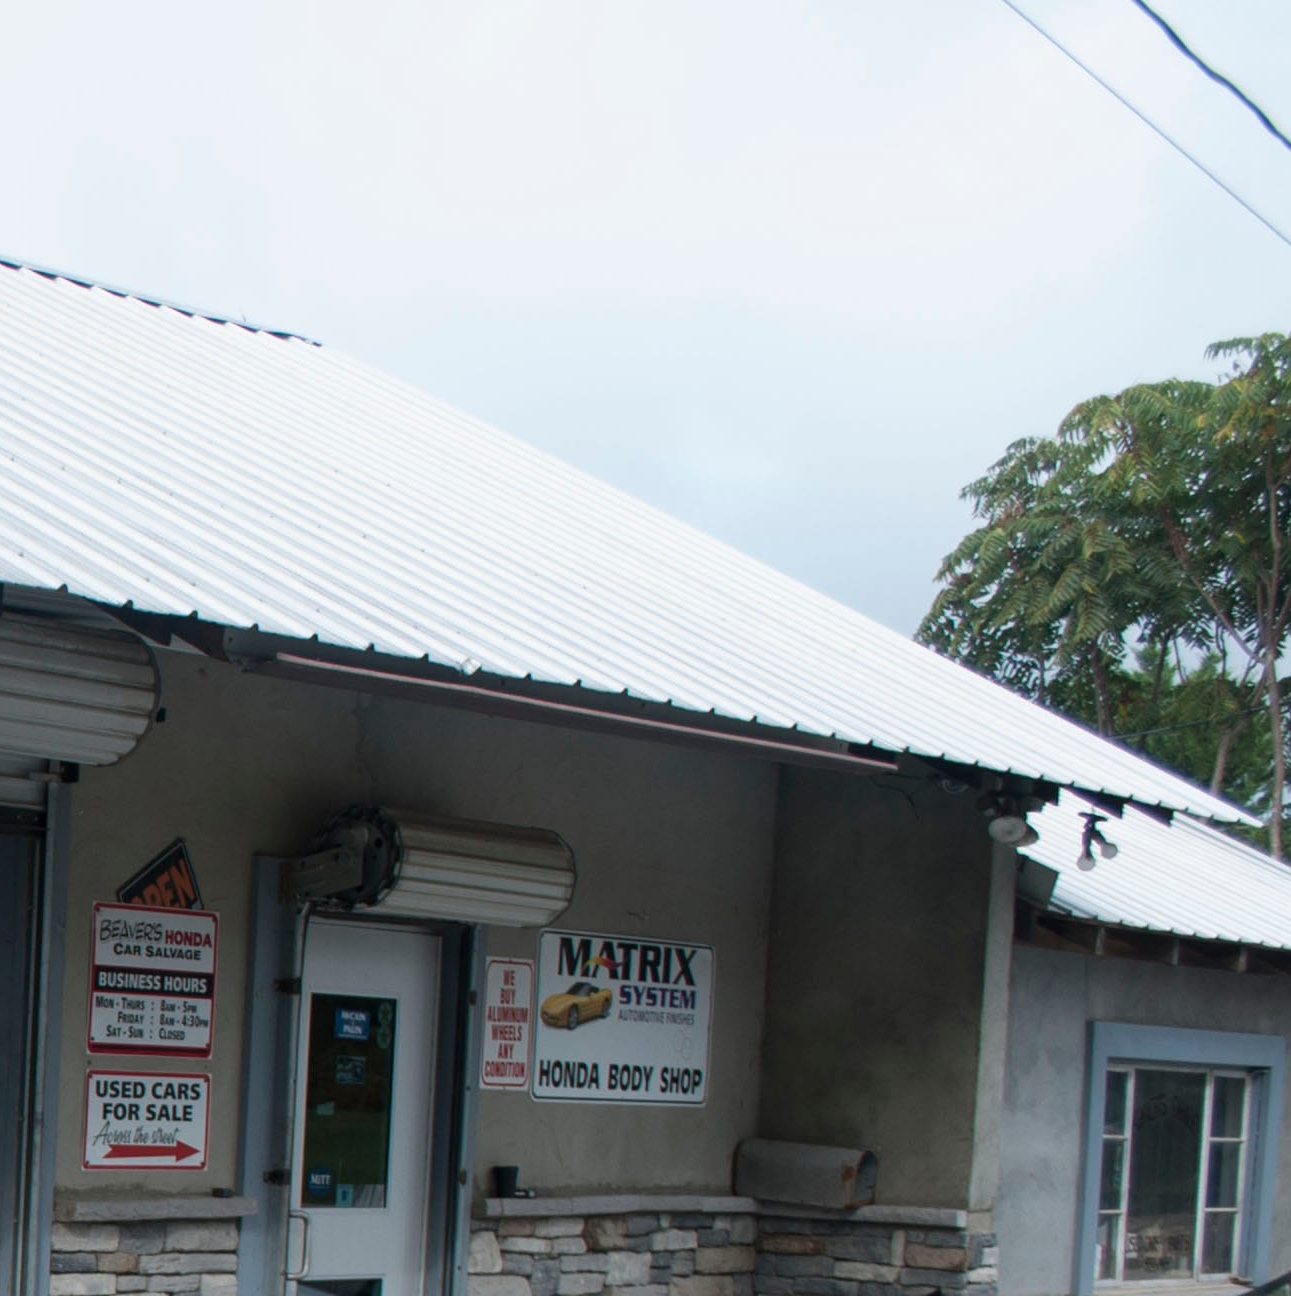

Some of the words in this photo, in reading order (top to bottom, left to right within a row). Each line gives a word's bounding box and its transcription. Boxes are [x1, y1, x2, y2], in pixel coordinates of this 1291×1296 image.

[100, 918, 163, 942] BEAVER'S
[165, 930, 212, 948] HONDA
[113, 943, 141, 956] CAR
[145, 945, 201, 961] SALVAGE
[557, 936, 698, 987] MATRIX
[98, 971, 161, 990] BUSINESS
[163, 975, 207, 993] HOURS
[503, 970, 516, 987] WE
[500, 988, 517, 1005] BUY
[619, 984, 697, 1010] SYSTEM
[487, 1006, 528, 1022] ALUMINUM
[618, 1010, 665, 1025] AUTOMOTIVE
[665, 1012, 695, 1025] FINISHES
[491, 1024, 523, 1041] WHEELS
[497, 1043, 515, 1059] ANY
[484, 1061, 525, 1077] CONDITION
[538, 1059, 599, 1089] HONDA
[607, 1063, 654, 1092] BODY
[659, 1066, 703, 1095] SHOP
[95, 1080, 145, 1099] USED
[152, 1082, 201, 1101] CARS
[102, 1103, 140, 1120] FOR
[145, 1104, 193, 1122] SALE
[92, 1120, 132, 1147] Across
[133, 1125, 149, 1144] the
[151, 1127, 180, 1145] street
